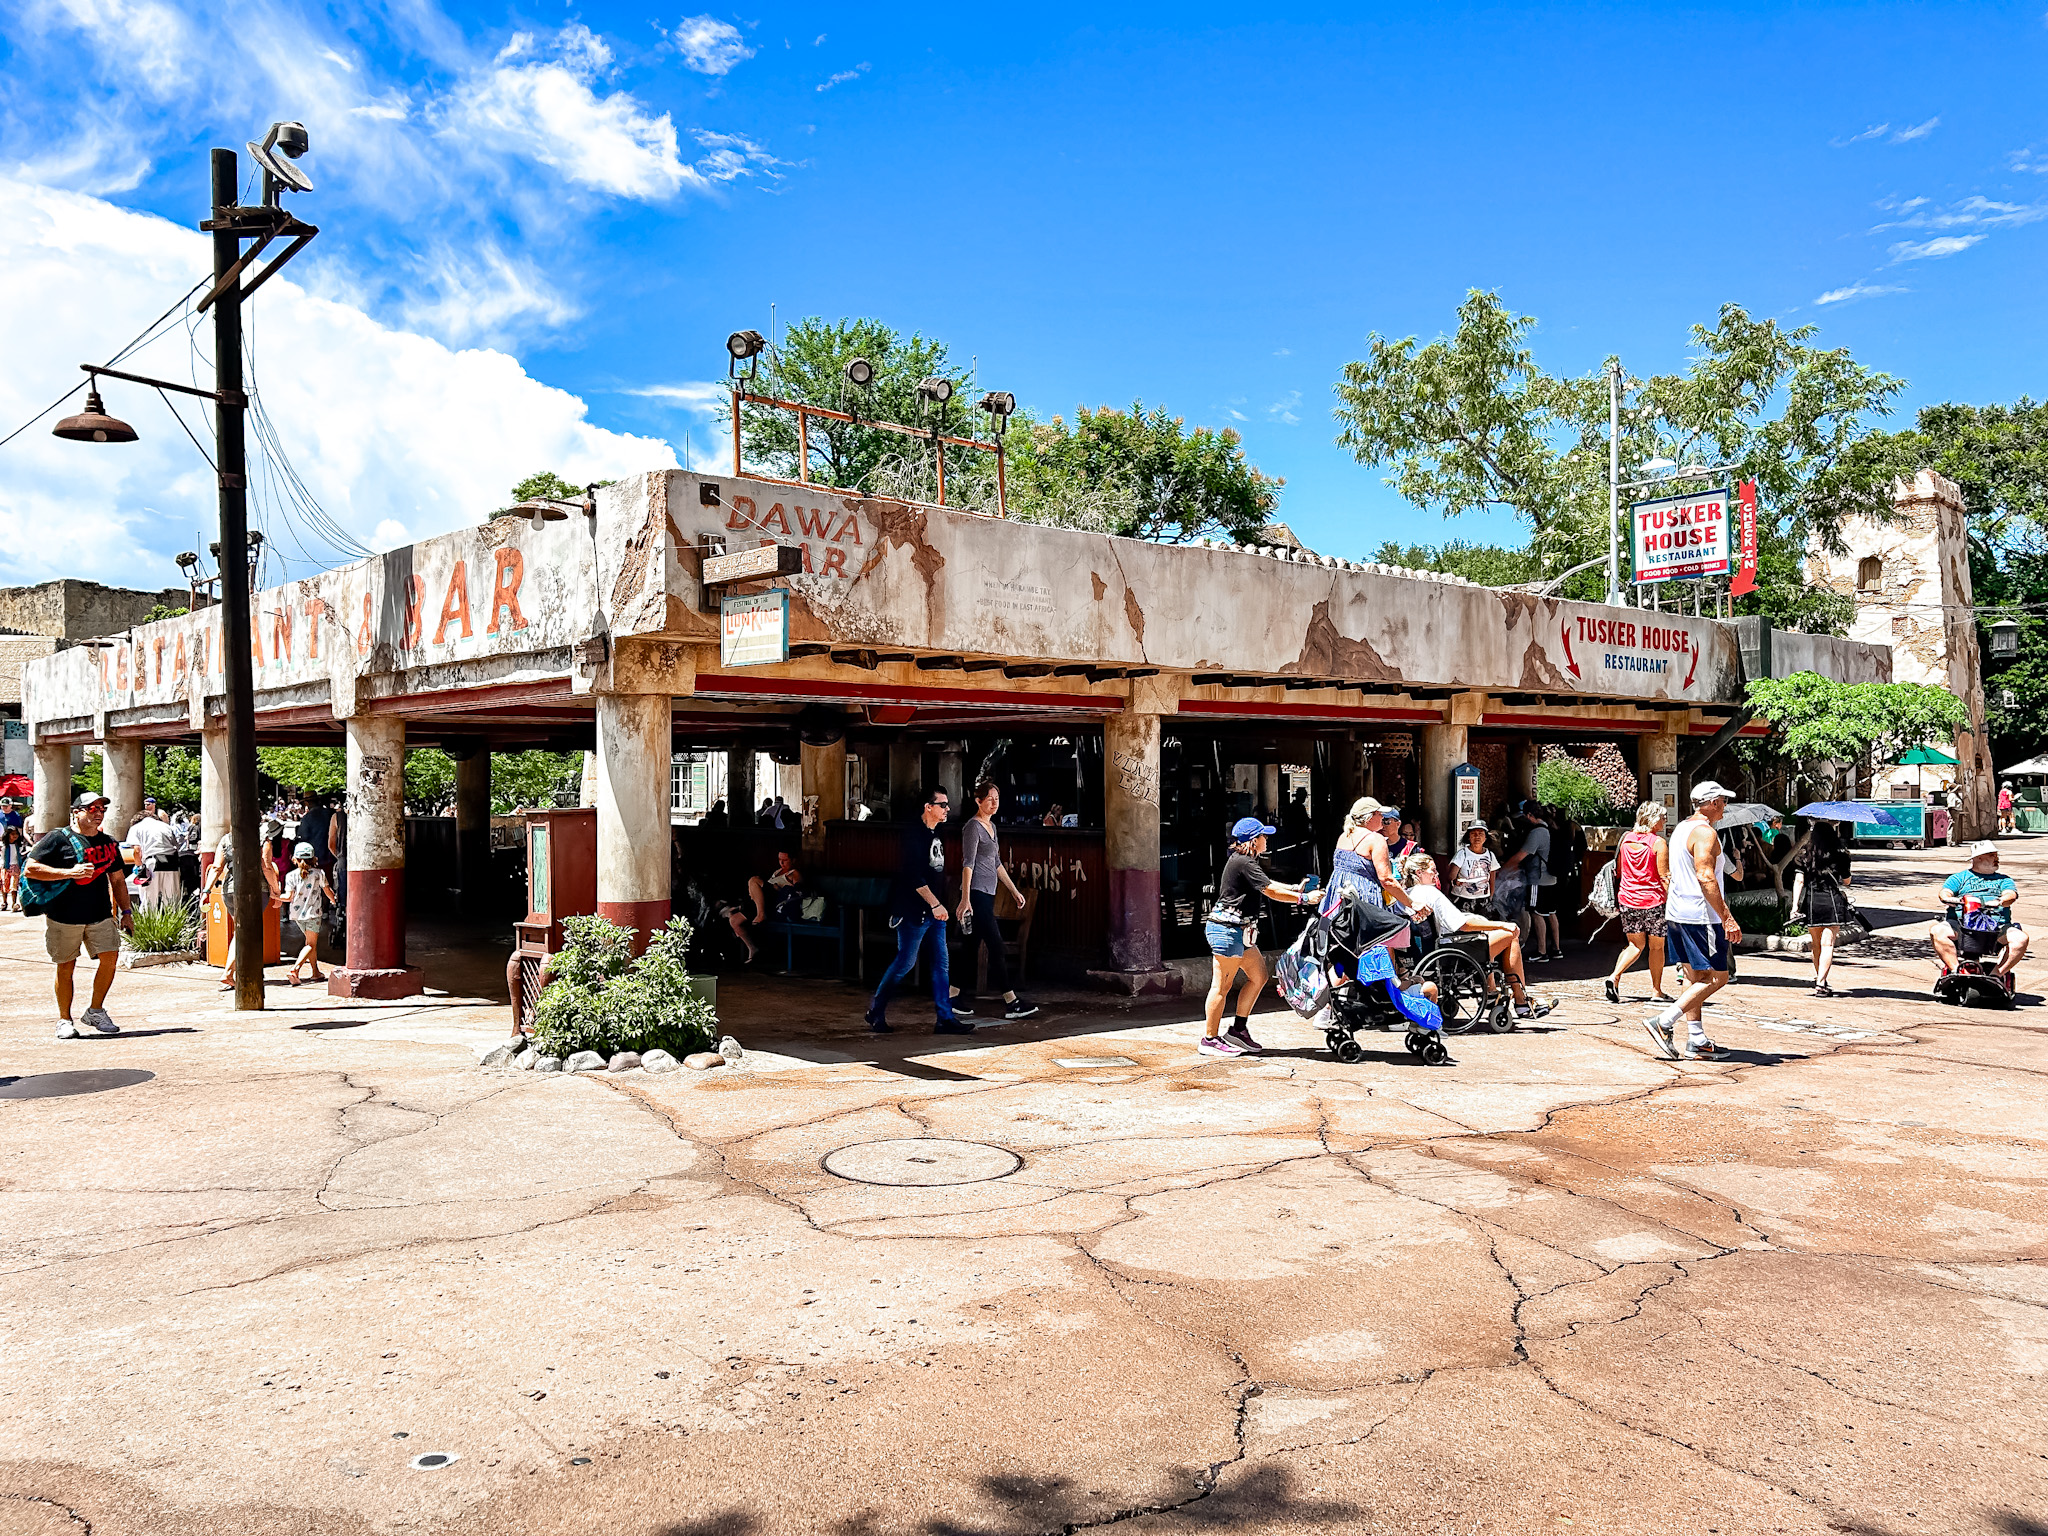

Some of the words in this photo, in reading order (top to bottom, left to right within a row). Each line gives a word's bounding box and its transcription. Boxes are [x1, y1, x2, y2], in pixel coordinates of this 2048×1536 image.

[725, 495, 863, 545] DAWA
[1639, 502, 1722, 532] TUSKER
[1743, 503, 1754, 547] CHECK
[1645, 526, 1718, 553] HOUSE
[1648, 546, 1717, 564] RESTAURANT
[1744, 549, 1754, 569] IN
[1643, 570, 1661, 578] GOOD
[1683, 564, 1699, 572] COLD
[1701, 562, 1720, 571] DRINKS
[358, 592, 373, 656] &
[400, 547, 529, 650] BAR
[994, 600, 1010, 609] FOOD
[1020, 603, 1033, 611] EAST
[1034, 604, 1053, 613] AFRICA
[726, 611, 750, 635] LION
[751, 606, 779, 632] KING
[1577, 616, 1637, 648] TUSKER
[1642, 625, 1690, 654] HOUSE
[1605, 653, 1668, 674] RESTAURANT
